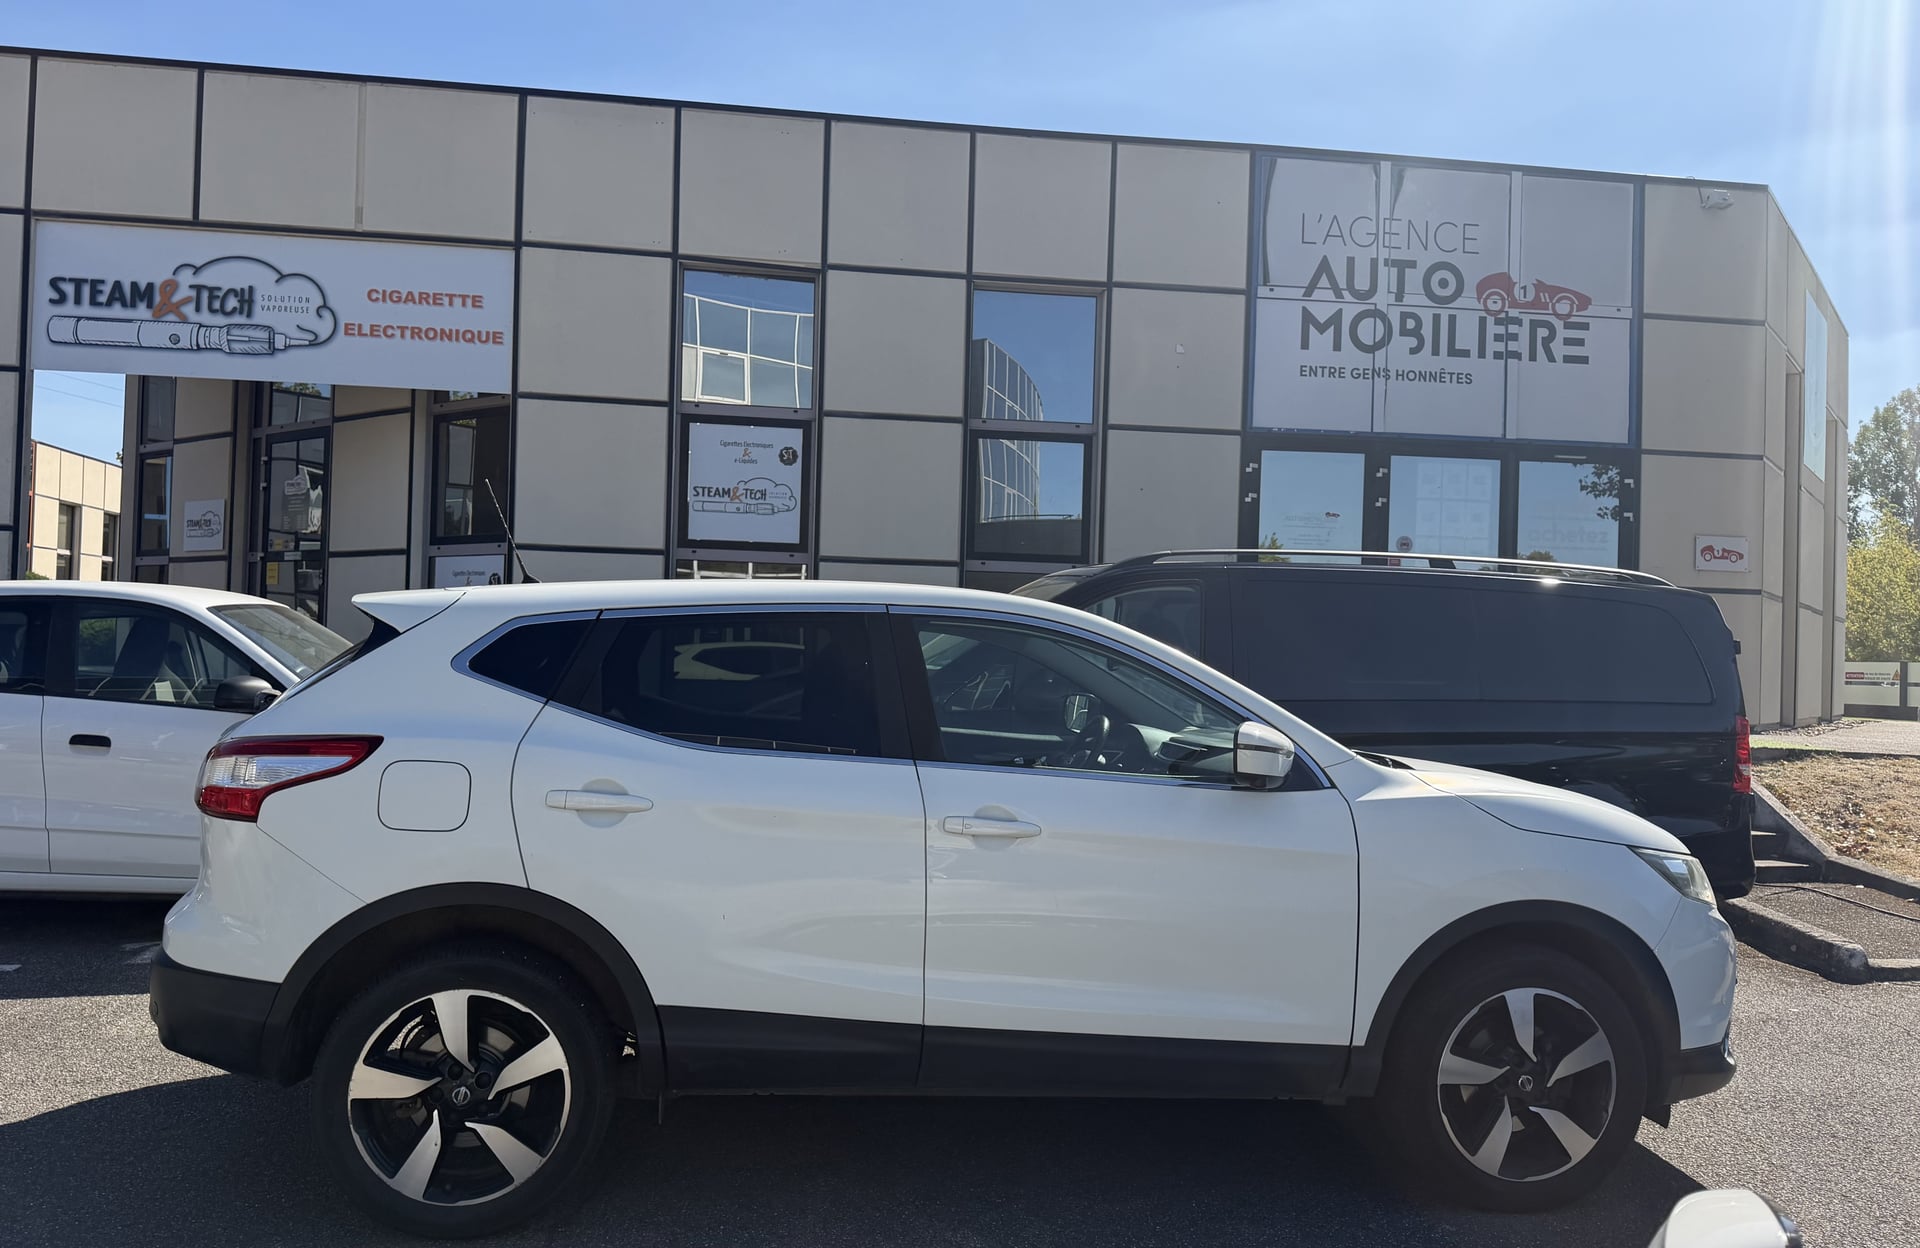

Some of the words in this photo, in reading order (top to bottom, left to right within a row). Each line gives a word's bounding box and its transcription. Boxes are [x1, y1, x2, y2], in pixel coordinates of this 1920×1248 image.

[1301, 212, 1480, 255] L'AGENCE
[1302, 254, 1465, 306] AUTO
[260, 294, 310, 304] SOLUTION
[260, 304, 310, 314] VAPOREUSE
[366, 288, 484, 309] CIGARETTE
[343, 322, 505, 345] ELECTRONIQUE
[1300, 305, 1590, 365] MOBILIERE
[1299, 364, 1347, 379] ENTRE
[1350, 366, 1391, 380] GENS
[1395, 367, 1473, 385] HONNÊTES
